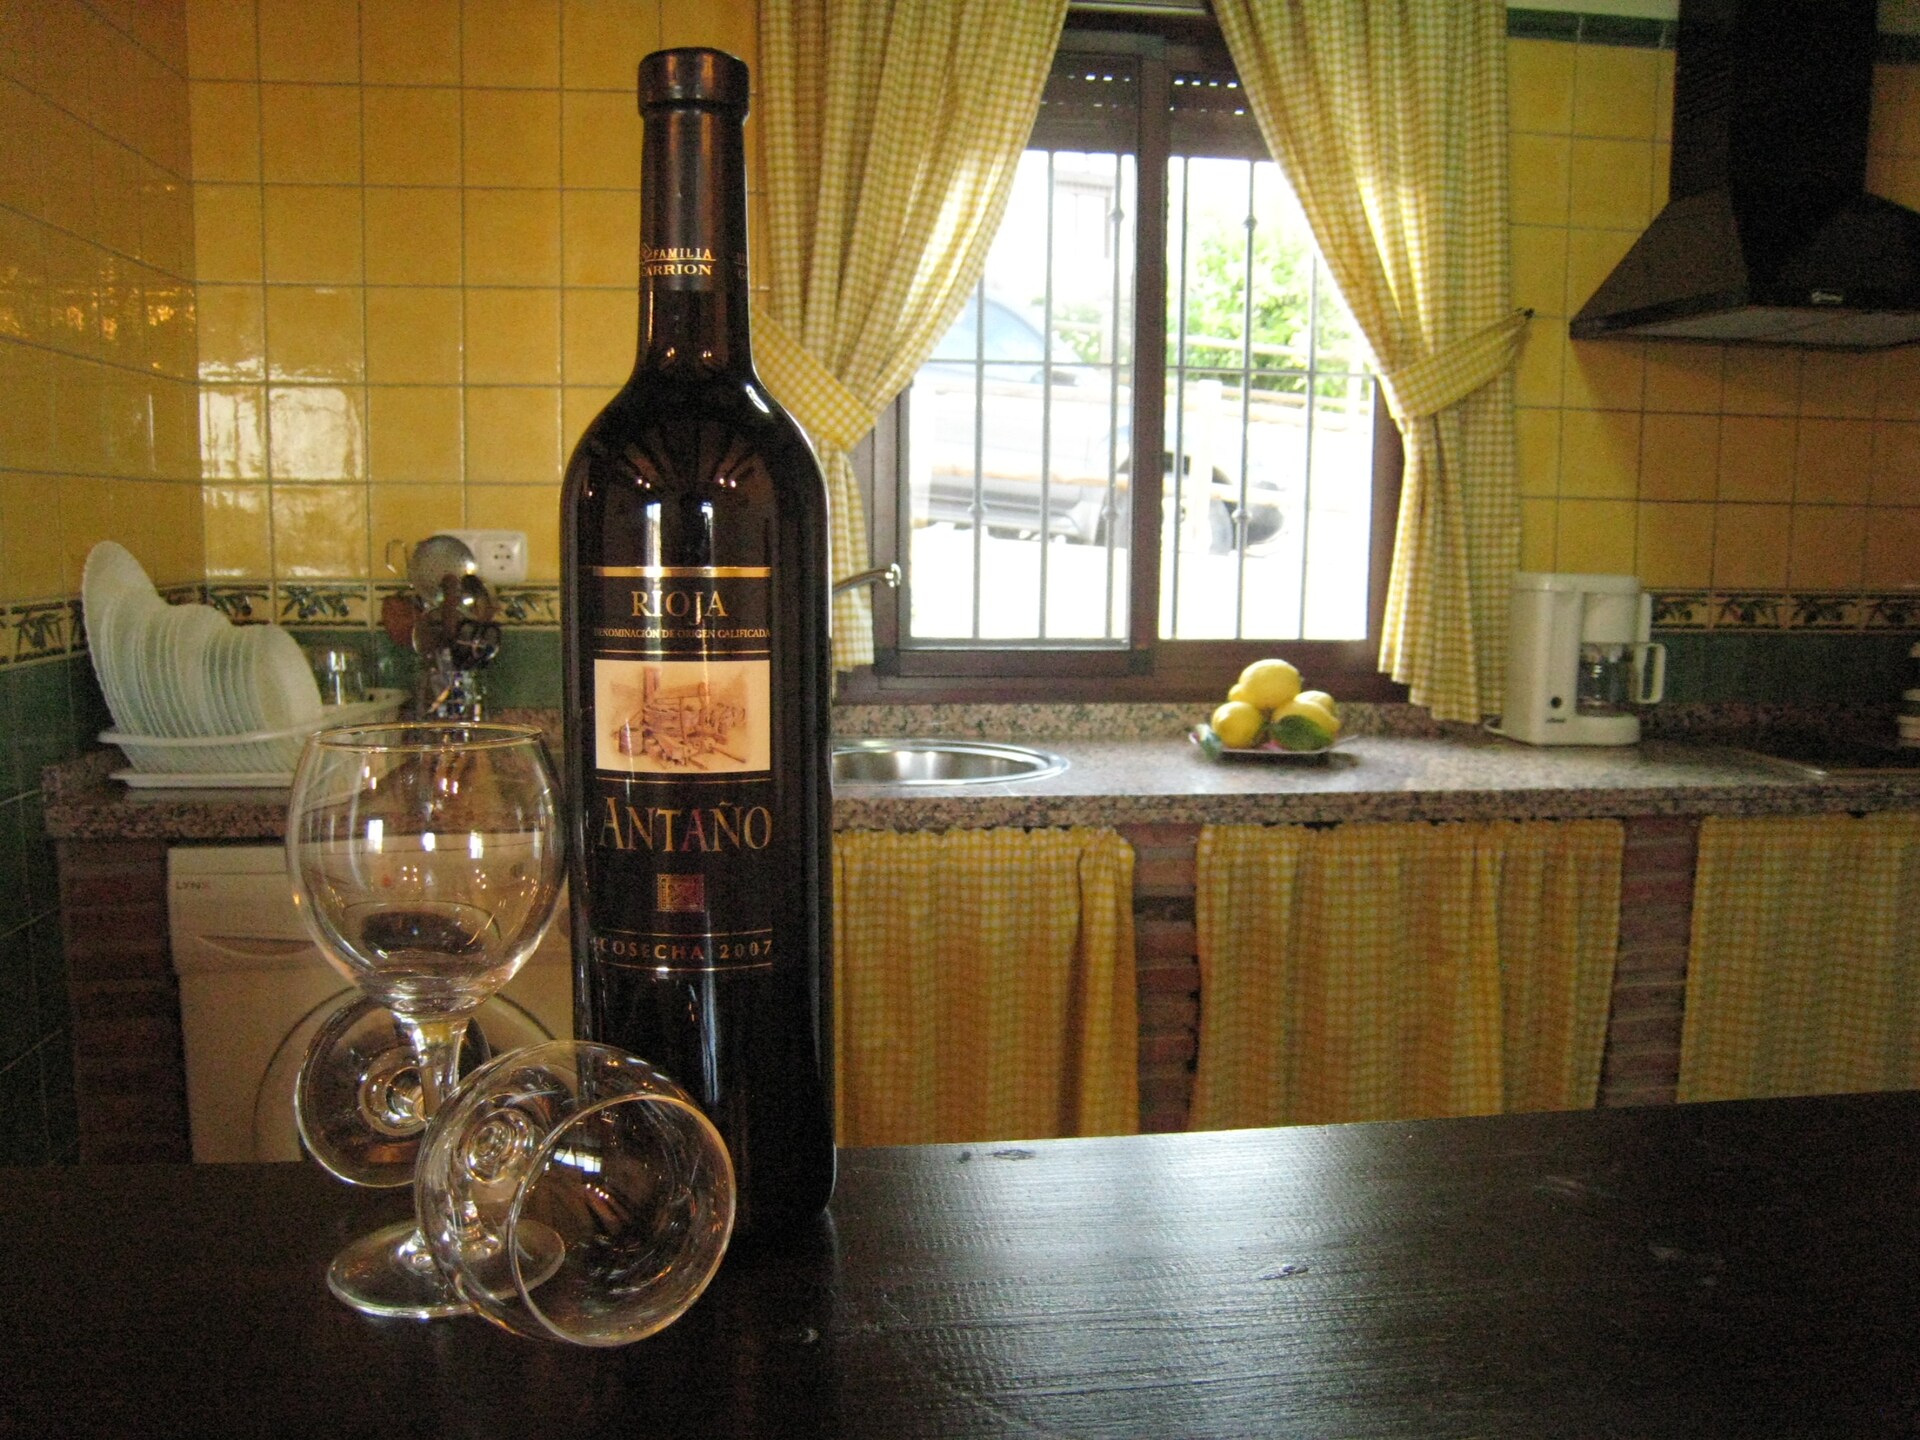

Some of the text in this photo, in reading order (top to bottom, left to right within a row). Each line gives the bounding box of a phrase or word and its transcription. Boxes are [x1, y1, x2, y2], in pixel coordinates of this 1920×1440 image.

[654, 248, 712, 259] FAMILIA
[631, 590, 729, 626] RIOJA
[717, 627, 771, 639] CALIFICADA
[600, 796, 773, 852] ANTAÑO
[599, 937, 773, 961] COSECHA 2007
